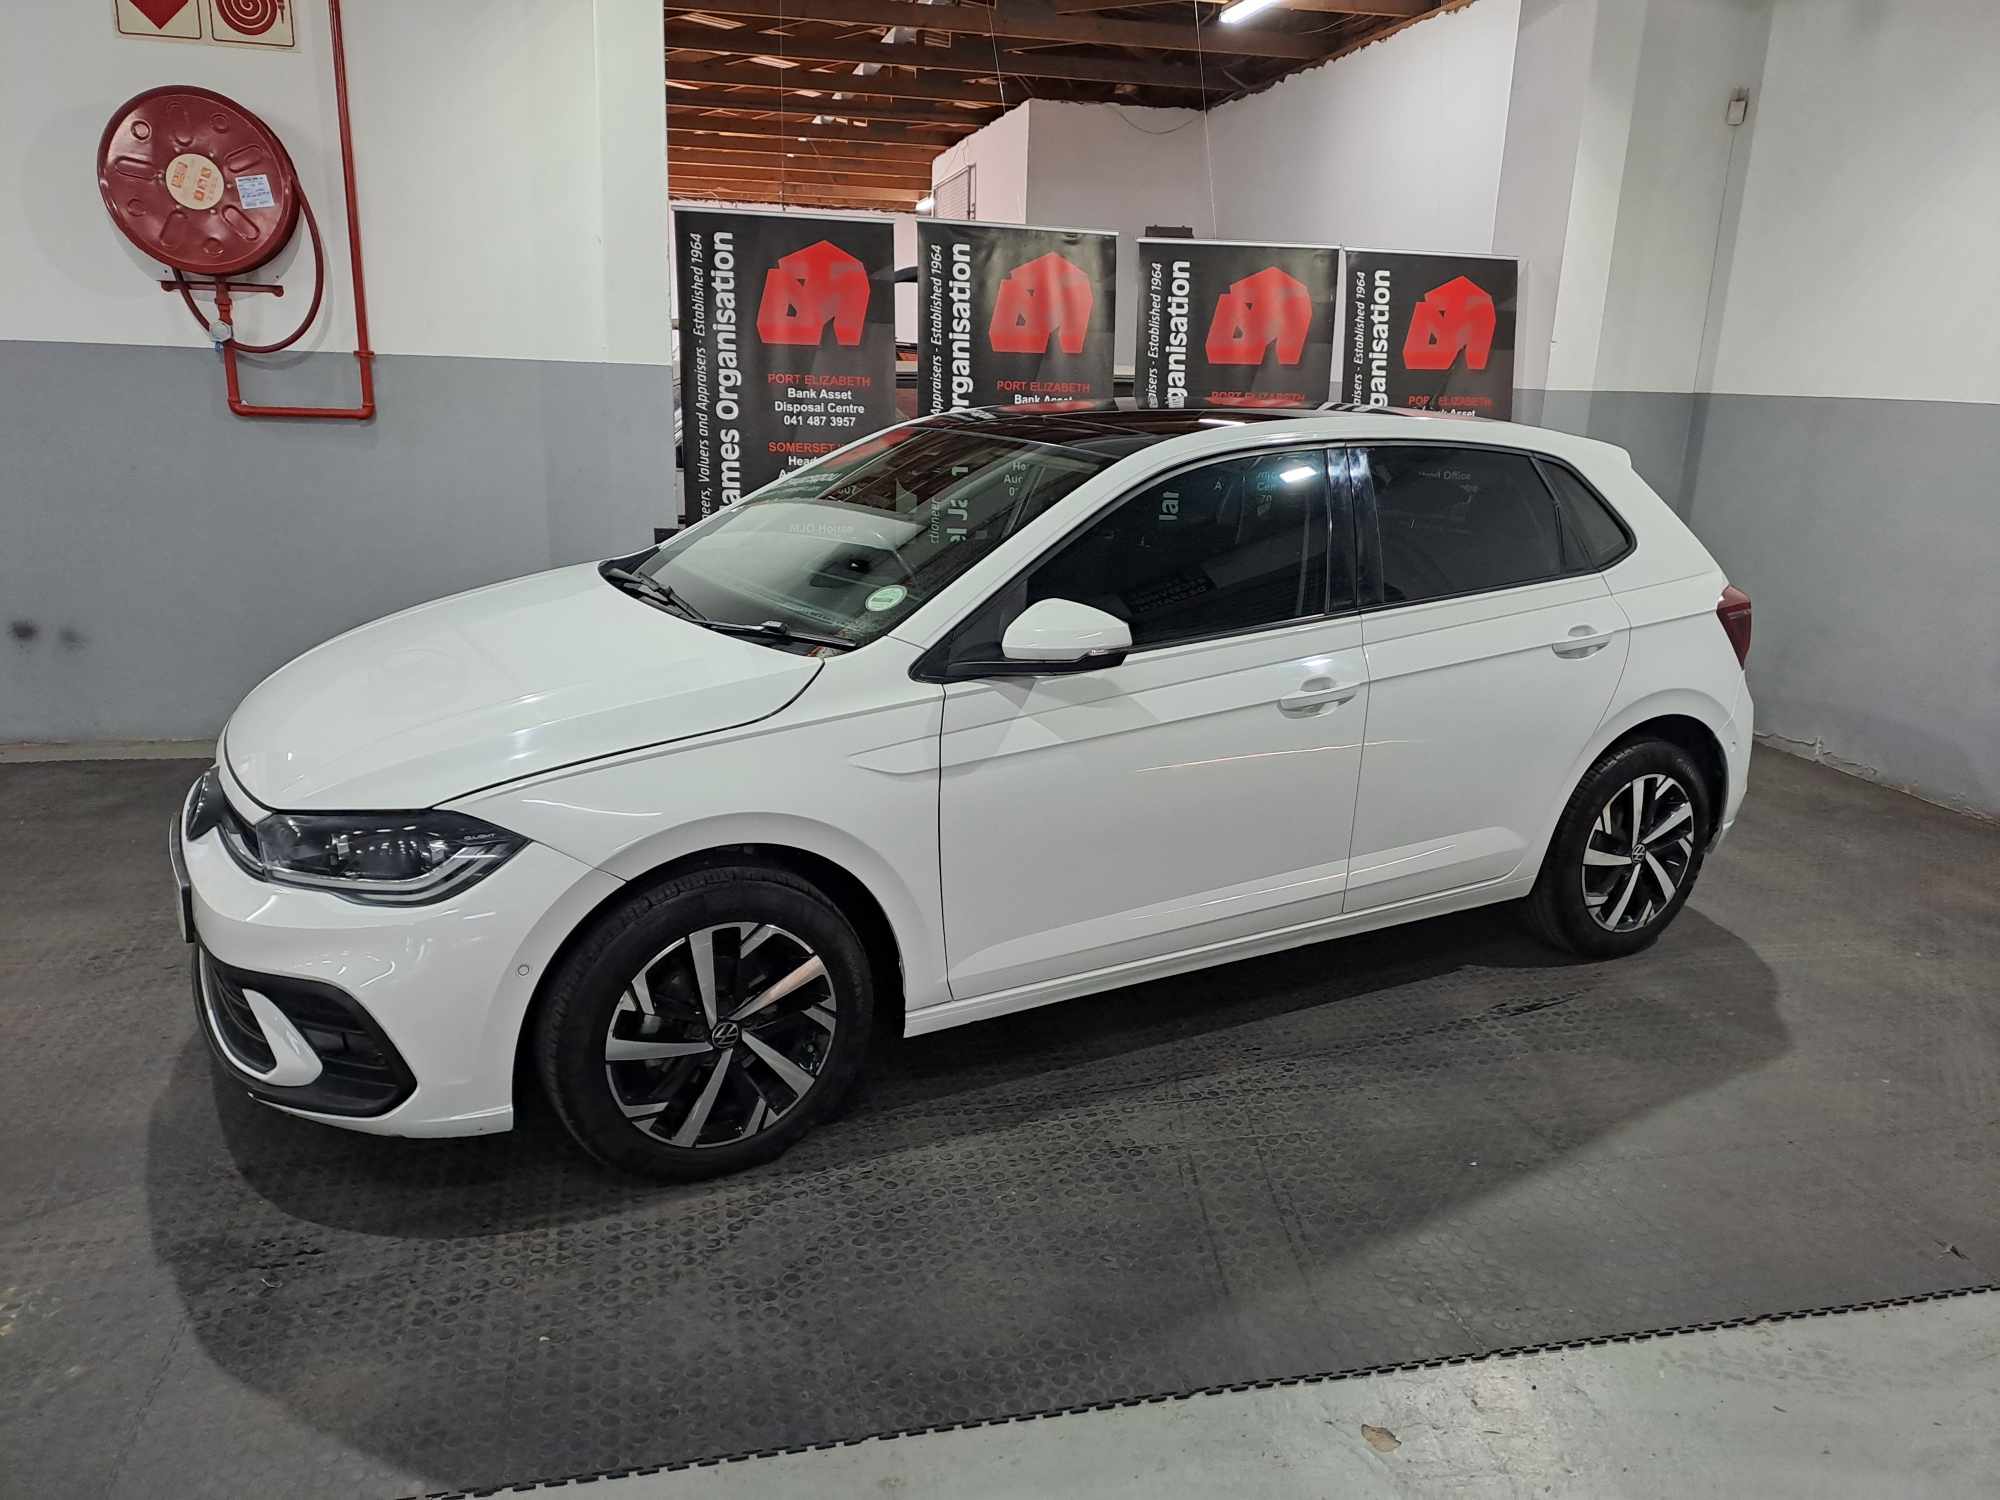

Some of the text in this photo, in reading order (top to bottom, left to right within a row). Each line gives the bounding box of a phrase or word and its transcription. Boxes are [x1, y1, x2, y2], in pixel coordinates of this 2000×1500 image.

[690, 232, 703, 263] 1964
[931, 244, 942, 275] 1964
[1151, 262, 1162, 291] 1964
[1355, 271, 1366, 299] 1964
[690, 265, 705, 337] Established
[930, 277, 943, 345] Established
[1148, 293, 1161, 358] Established
[1354, 301, 1366, 365] Established
[694, 347, 710, 410] Appraisers
[711, 231, 741, 512] ames Organisation
[767, 373, 872, 386] PORT ELIZABETH
[996, 380, 1090, 393] PORT ELIZABETH
[774, 401, 865, 414] Disposal Centre
[787, 387, 852, 400] Bank Asset
[1014, 394, 1040, 404] Bank
[696, 412, 709, 437] and
[783, 415, 856, 427] 041 487 3957
[697, 439, 710, 482] Valuers
